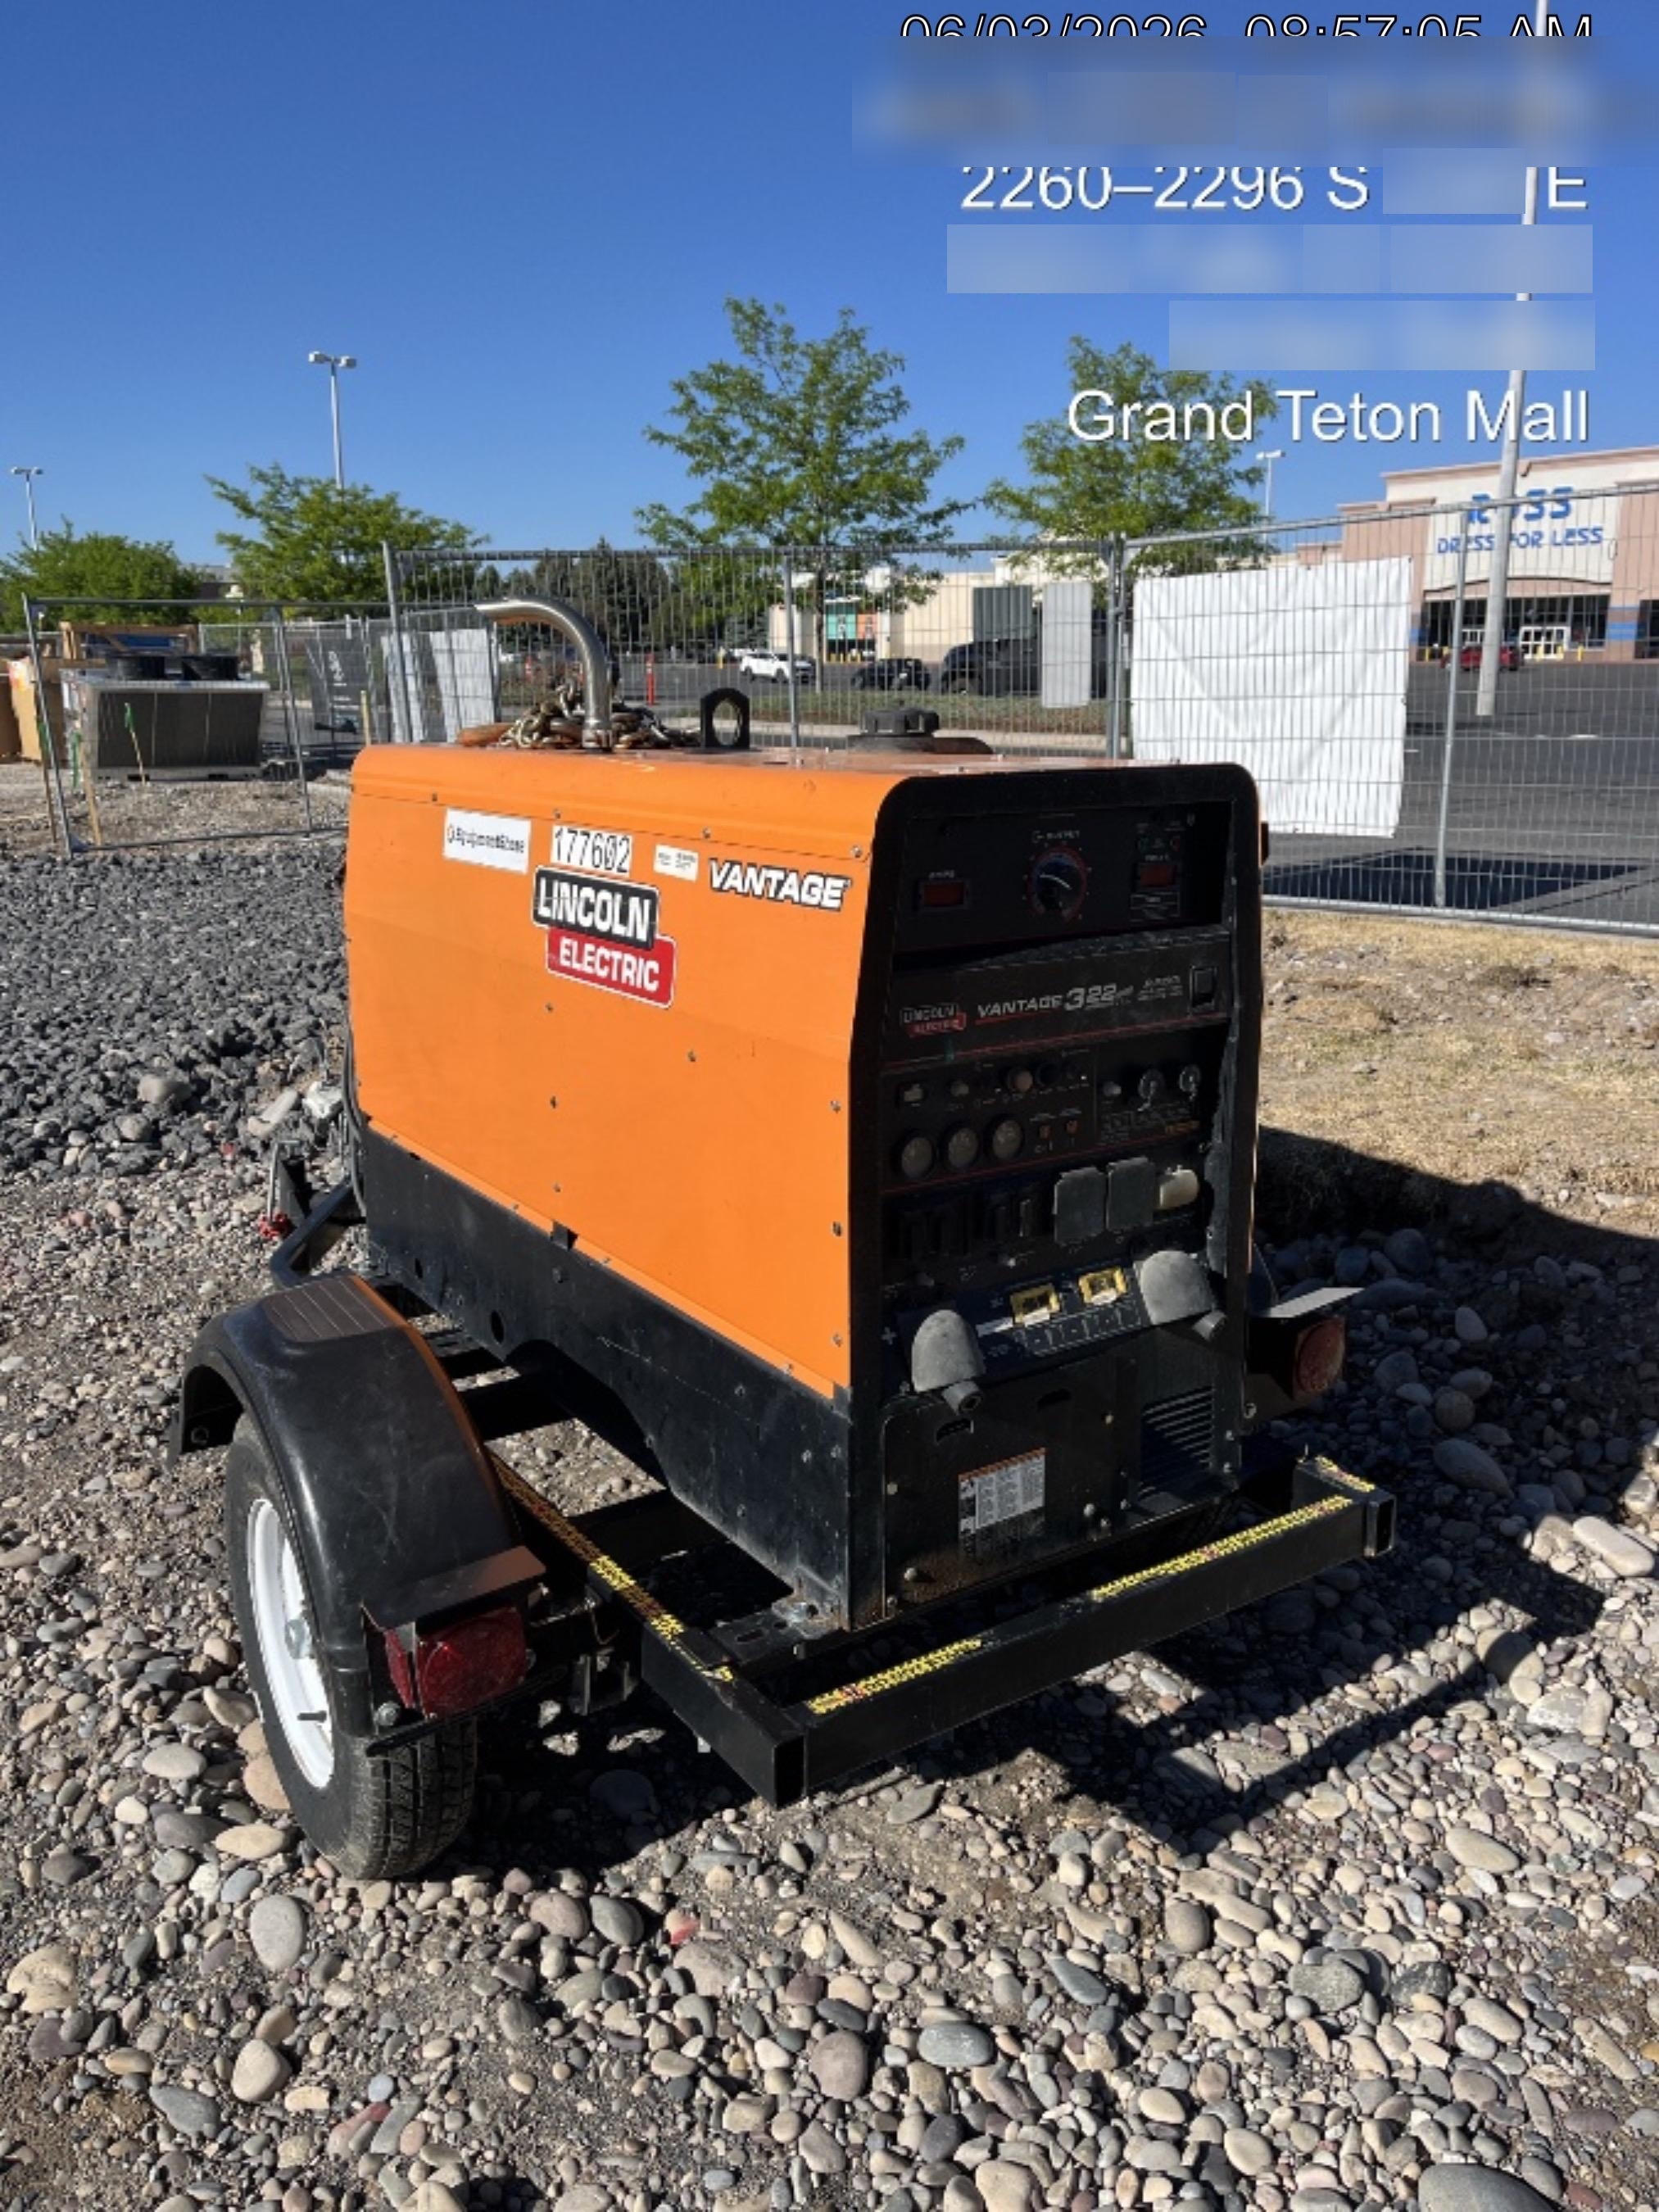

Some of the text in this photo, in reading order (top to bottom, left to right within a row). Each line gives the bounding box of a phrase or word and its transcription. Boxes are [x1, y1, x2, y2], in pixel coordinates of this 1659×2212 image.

[1466, 487, 1573, 524] RSS
[1551, 526, 1603, 546] LESS
[554, 827, 632, 874] 177602
[709, 859, 849, 910] VANTAGE
[537, 877, 652, 942] LINCOLN
[559, 937, 660, 992] ELECTRIC
[977, 994, 1063, 1018] VANTAGE
